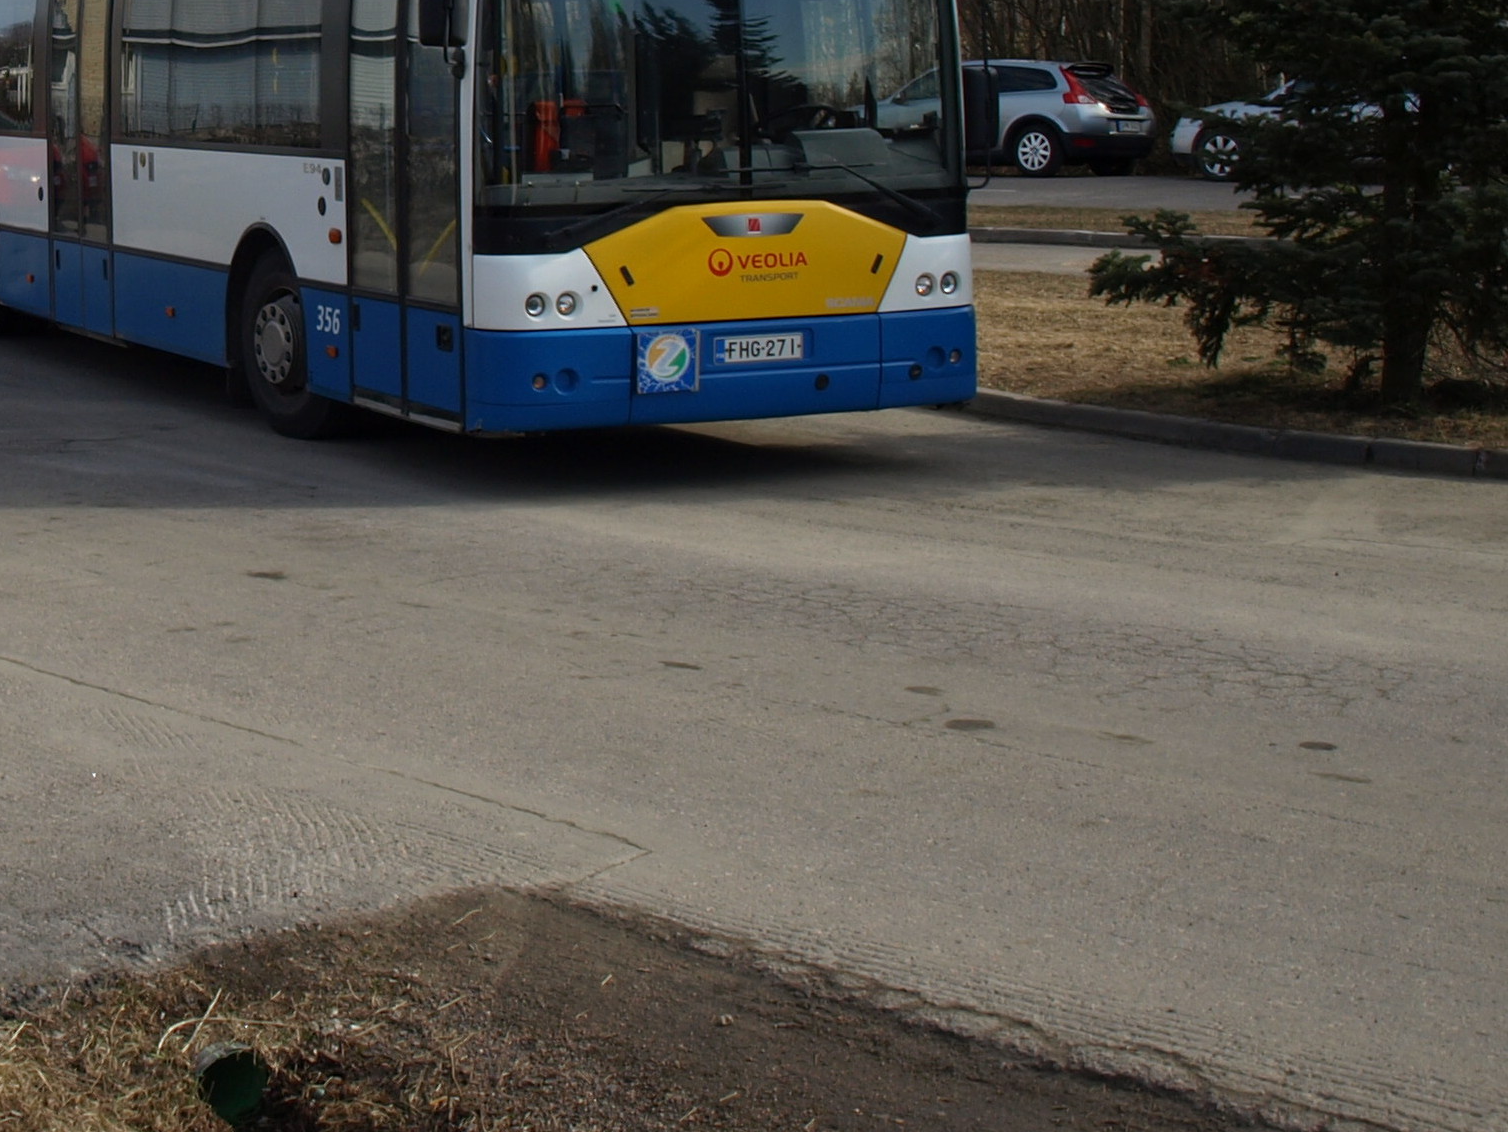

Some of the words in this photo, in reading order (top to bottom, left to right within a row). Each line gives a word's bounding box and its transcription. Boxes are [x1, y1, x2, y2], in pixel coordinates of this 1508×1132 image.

[737, 251, 809, 270] VEOLIA
[740, 271, 800, 283] TRANSPORT
[315, 304, 341, 335] 356
[728, 337, 795, 360] FHG-271
